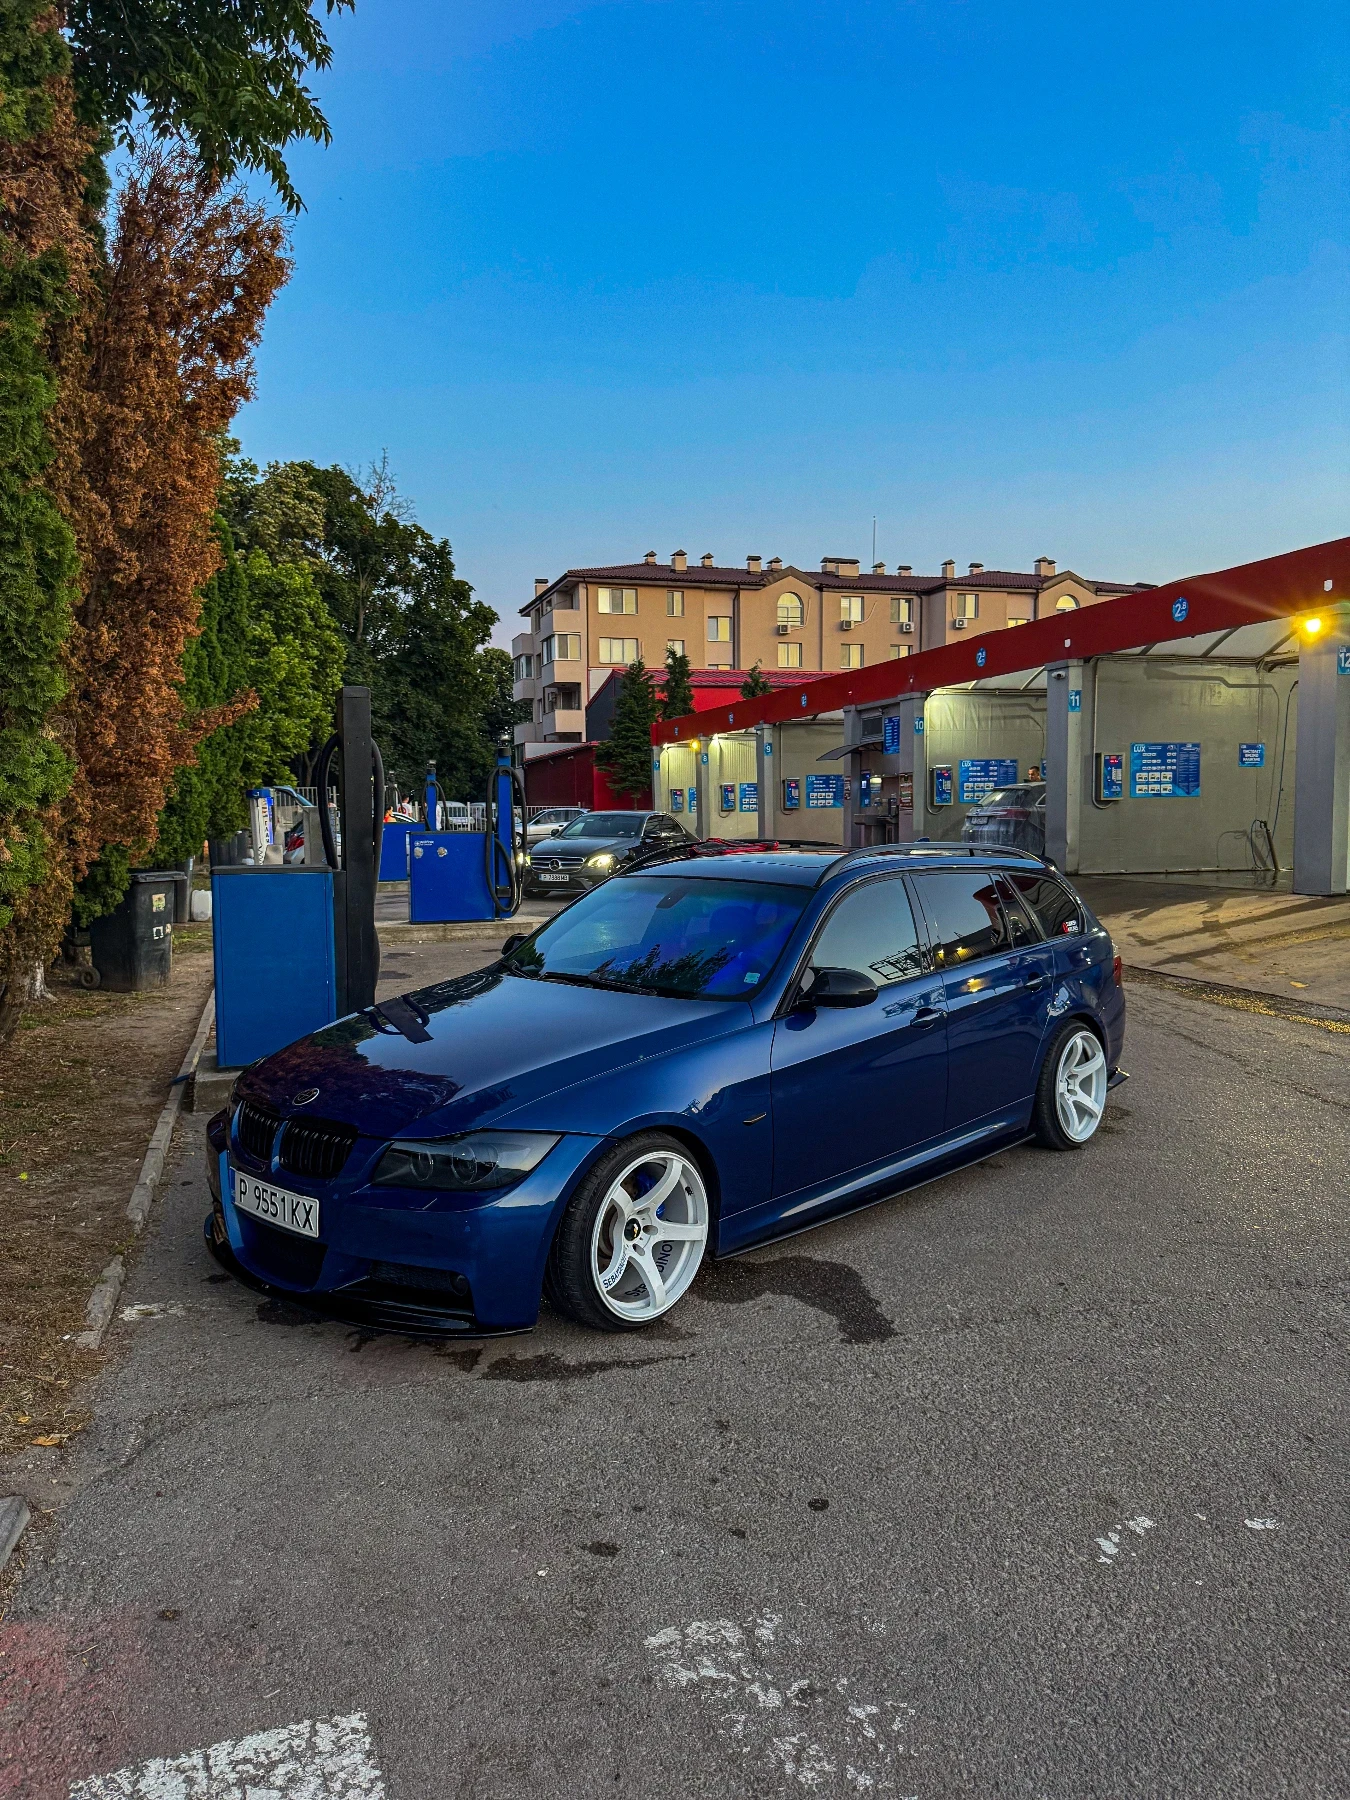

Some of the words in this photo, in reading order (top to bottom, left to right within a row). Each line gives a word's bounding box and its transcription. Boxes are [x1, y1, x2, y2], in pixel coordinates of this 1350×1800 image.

[1070, 695, 1079, 706] 11
[915, 720, 923, 730] 10
[1134, 744, 1146, 752] LUX
[239, 1177, 249, 1203] P
